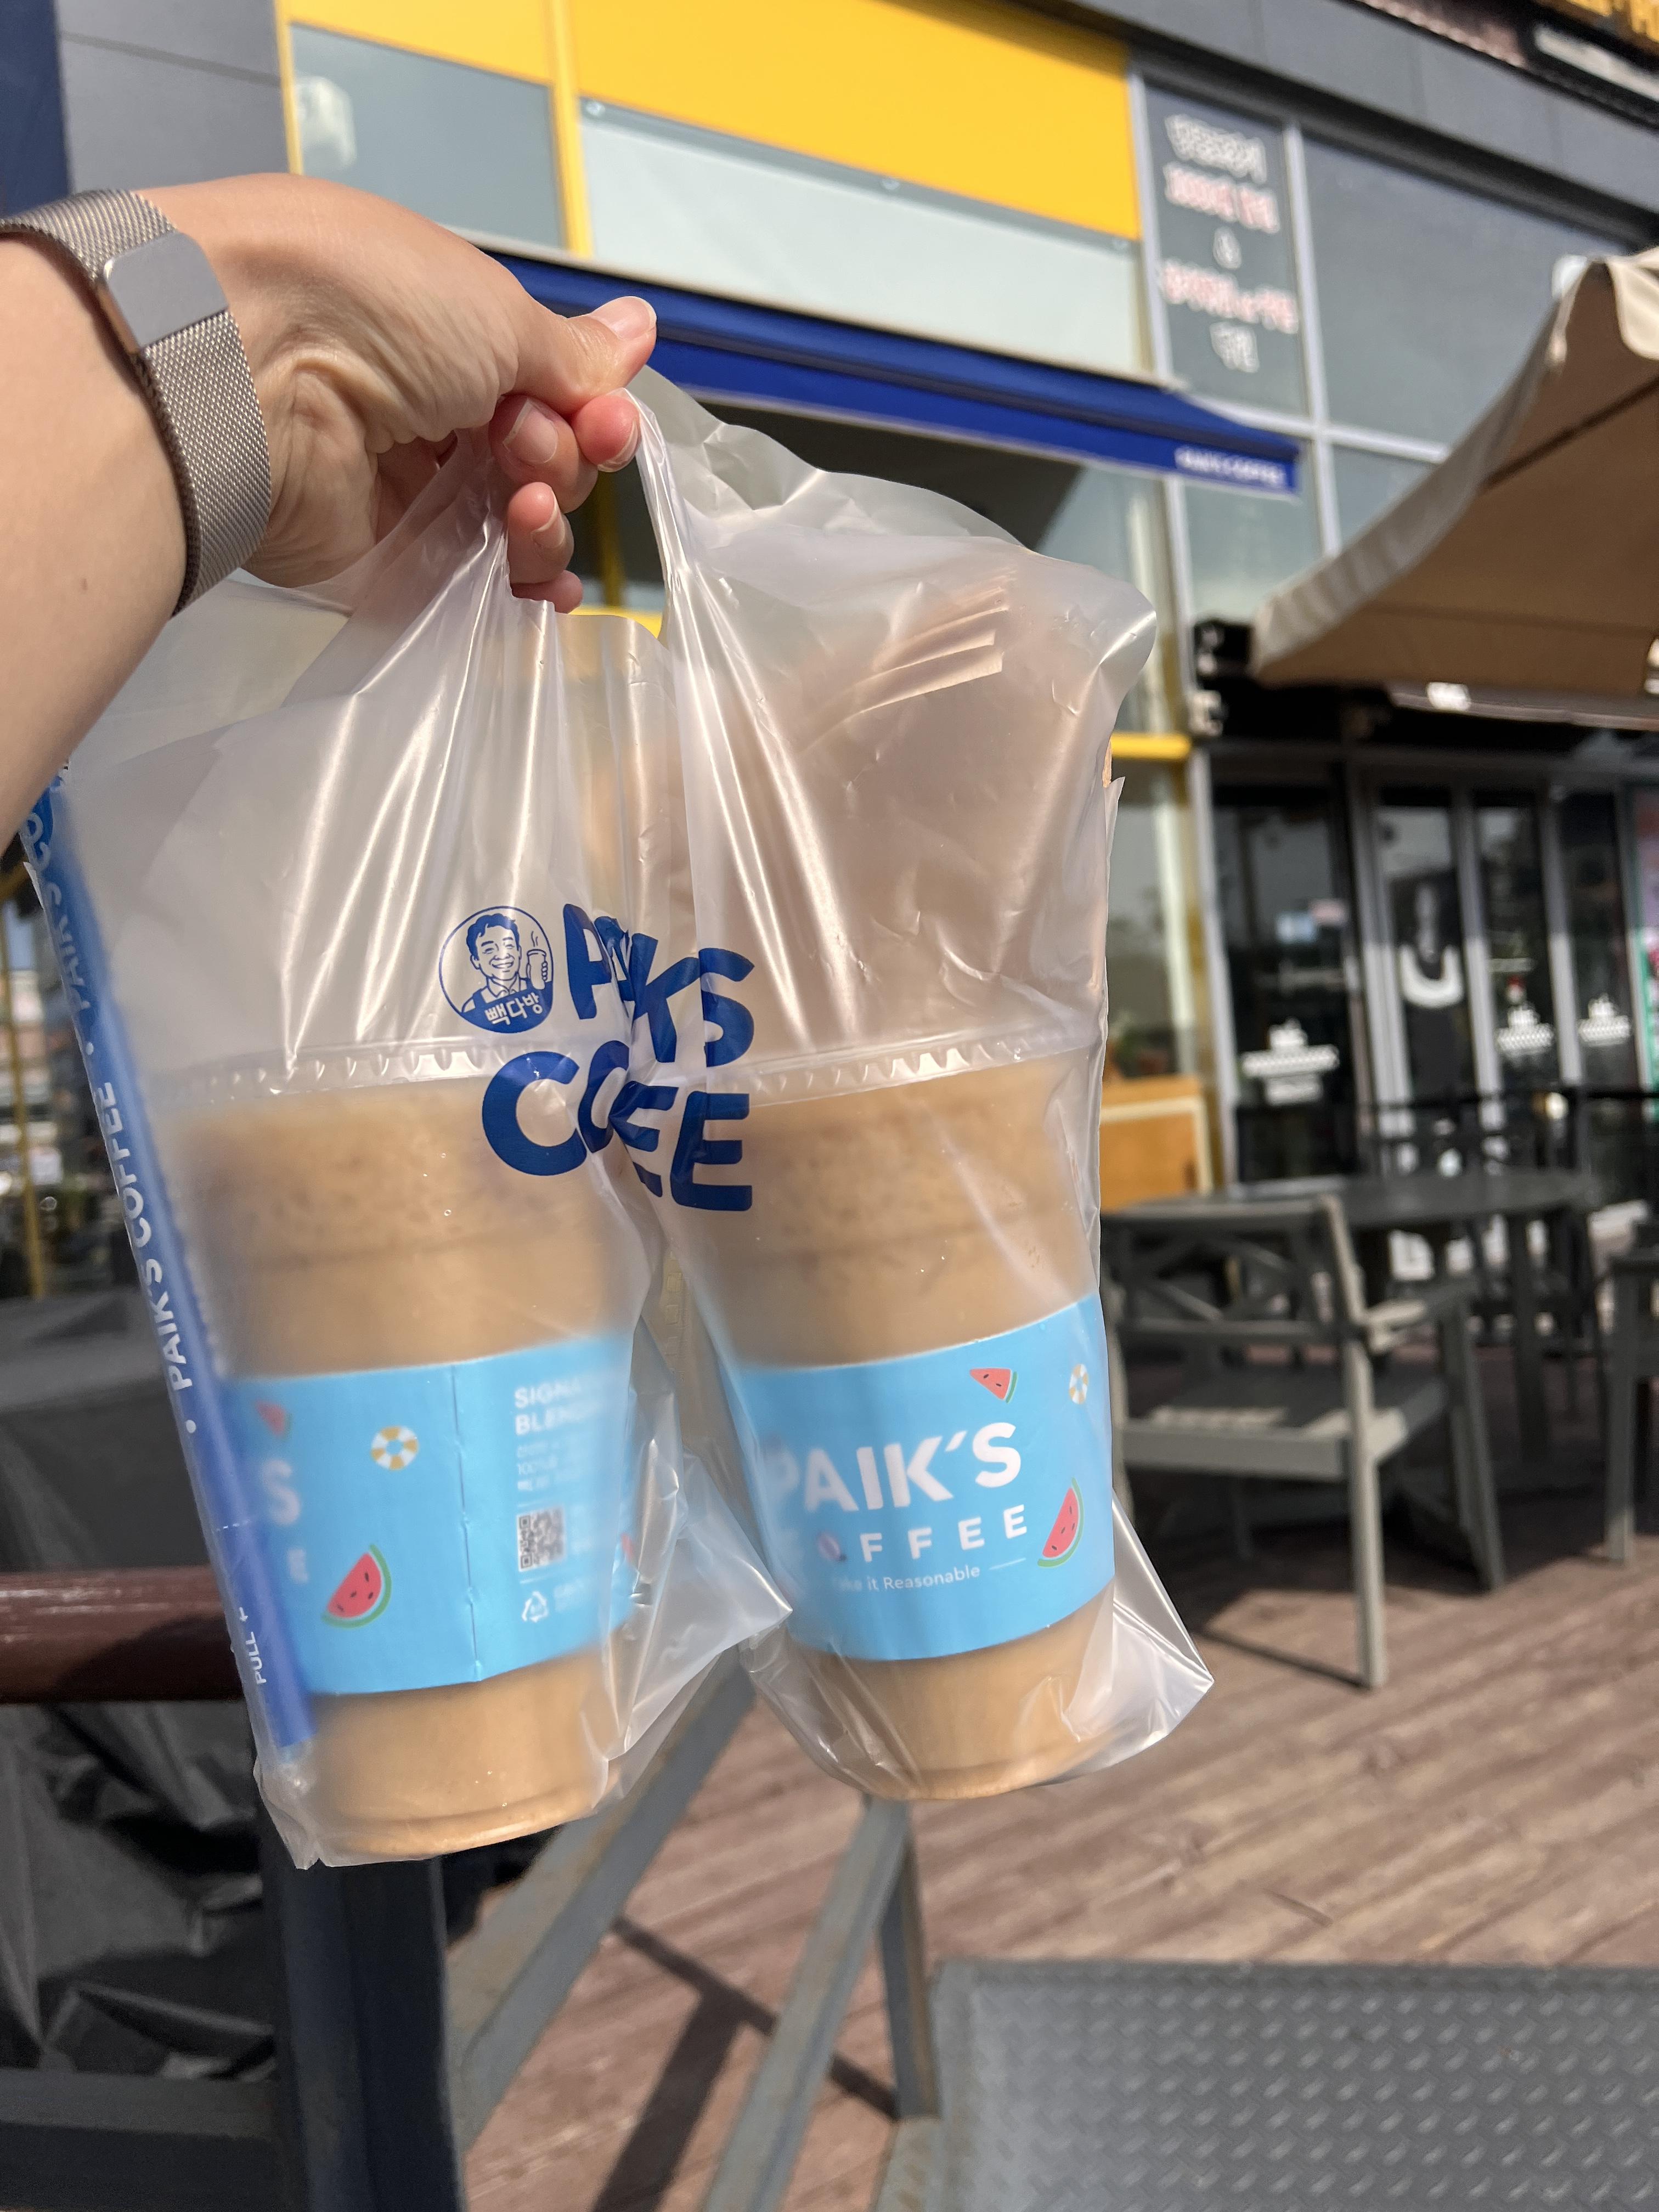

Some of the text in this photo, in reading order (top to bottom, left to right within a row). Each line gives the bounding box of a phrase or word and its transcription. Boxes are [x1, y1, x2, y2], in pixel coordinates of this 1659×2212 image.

[484, 991, 543, 1025] 빽다방
[98, 1082, 151, 1248] COFFEE
[867, 1575, 879, 1591] it
[884, 1564, 980, 1590] Reasonable
[245, 1631, 267, 1685] PULL
